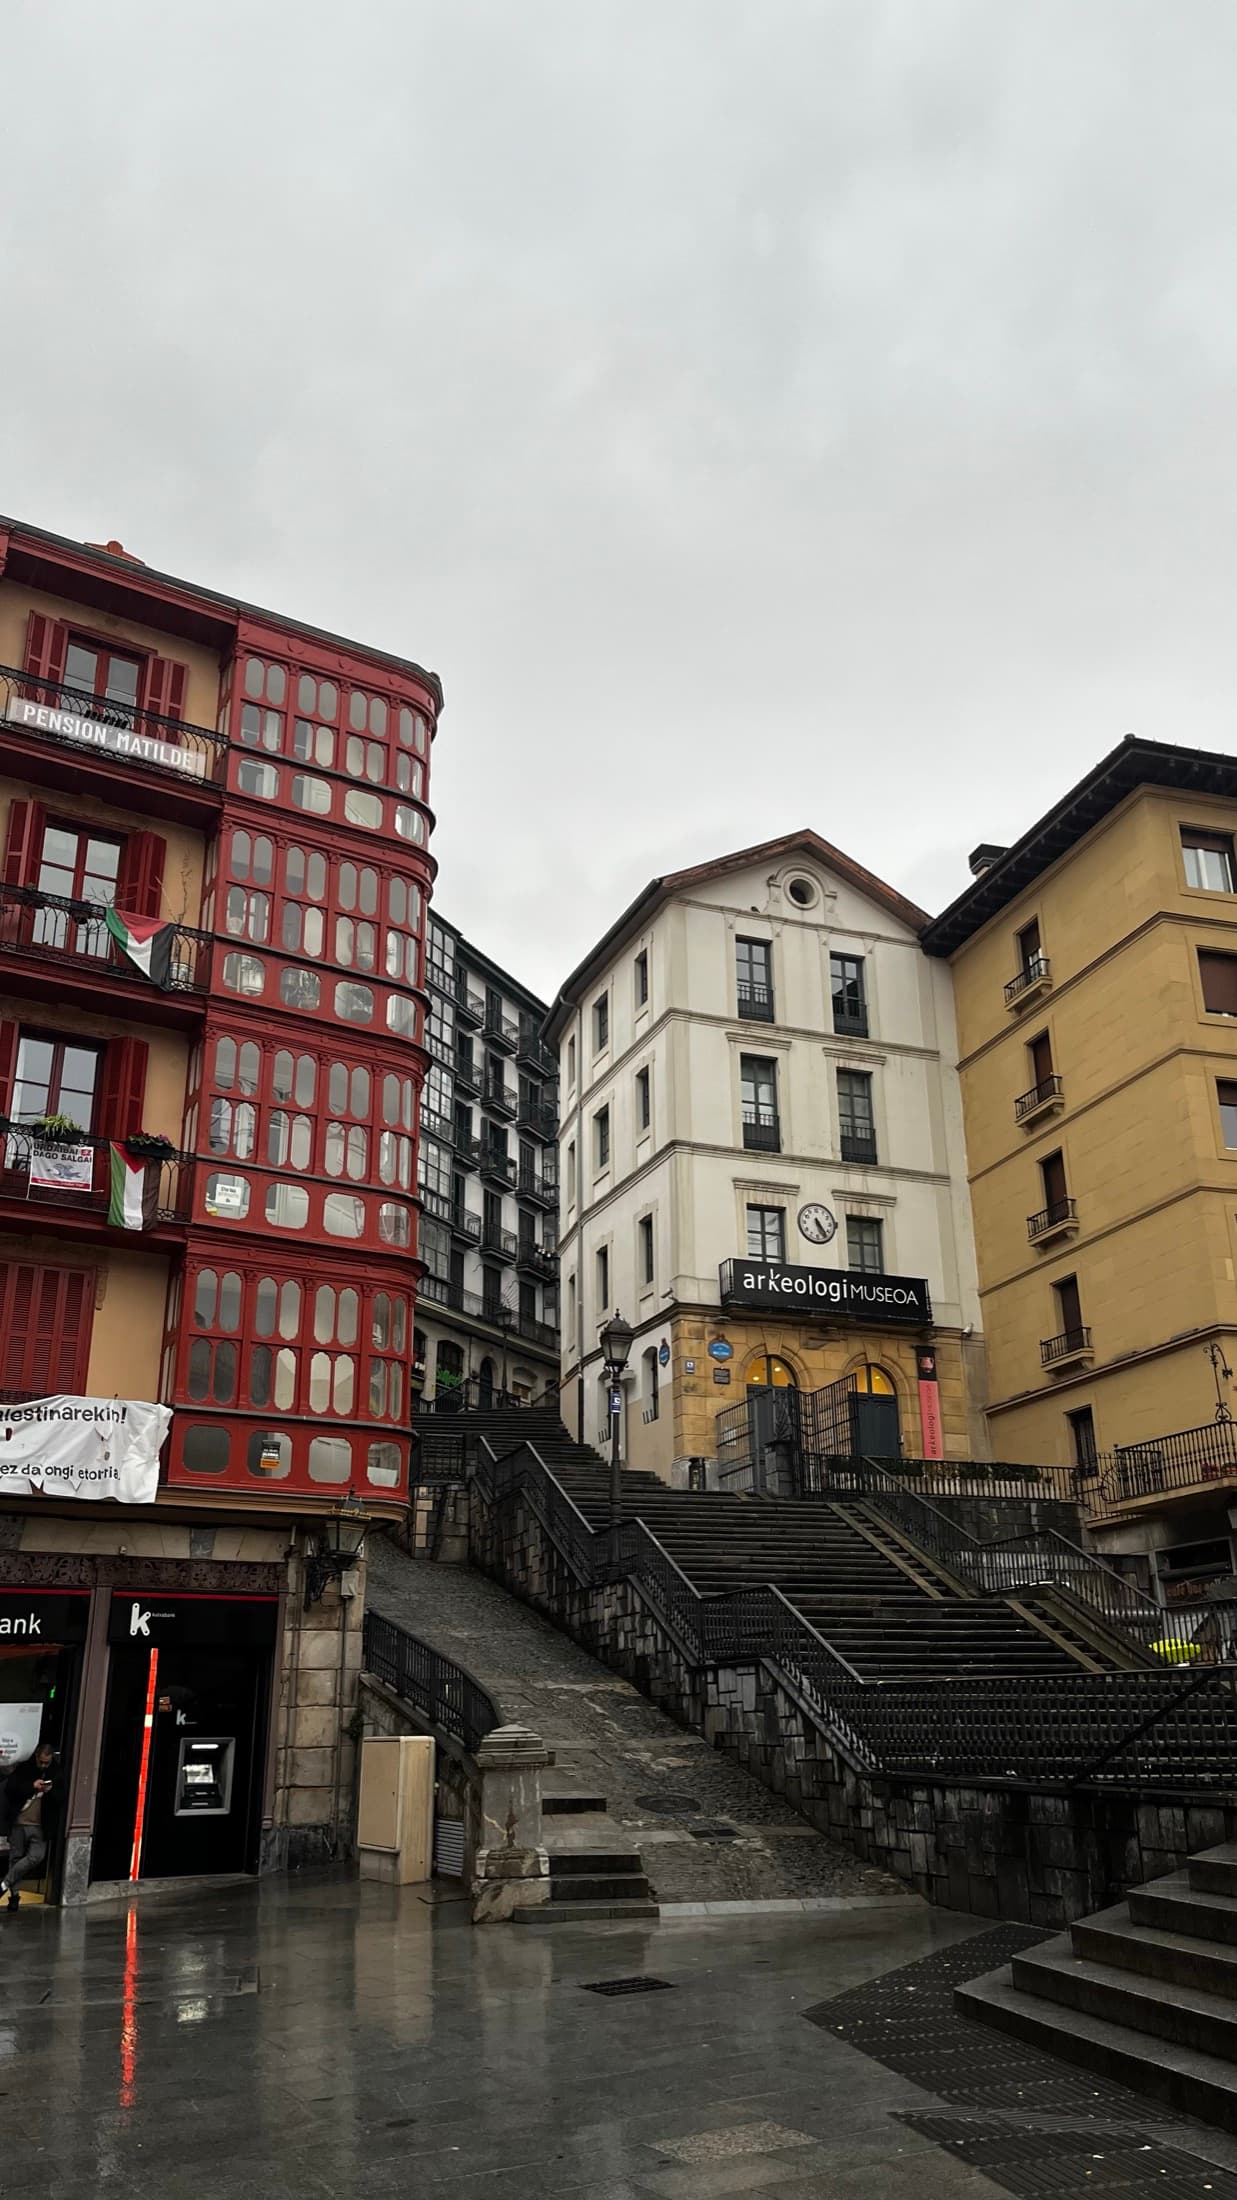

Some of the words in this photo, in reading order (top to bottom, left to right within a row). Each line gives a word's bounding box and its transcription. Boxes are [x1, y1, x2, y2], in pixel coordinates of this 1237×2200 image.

[23, 704, 107, 744] PENSION
[116, 732, 193, 769] MATILDE
[33, 1150, 58, 1160] DAGO
[21, 1464, 41, 1476] da
[45, 1464, 74, 1480] ongi
